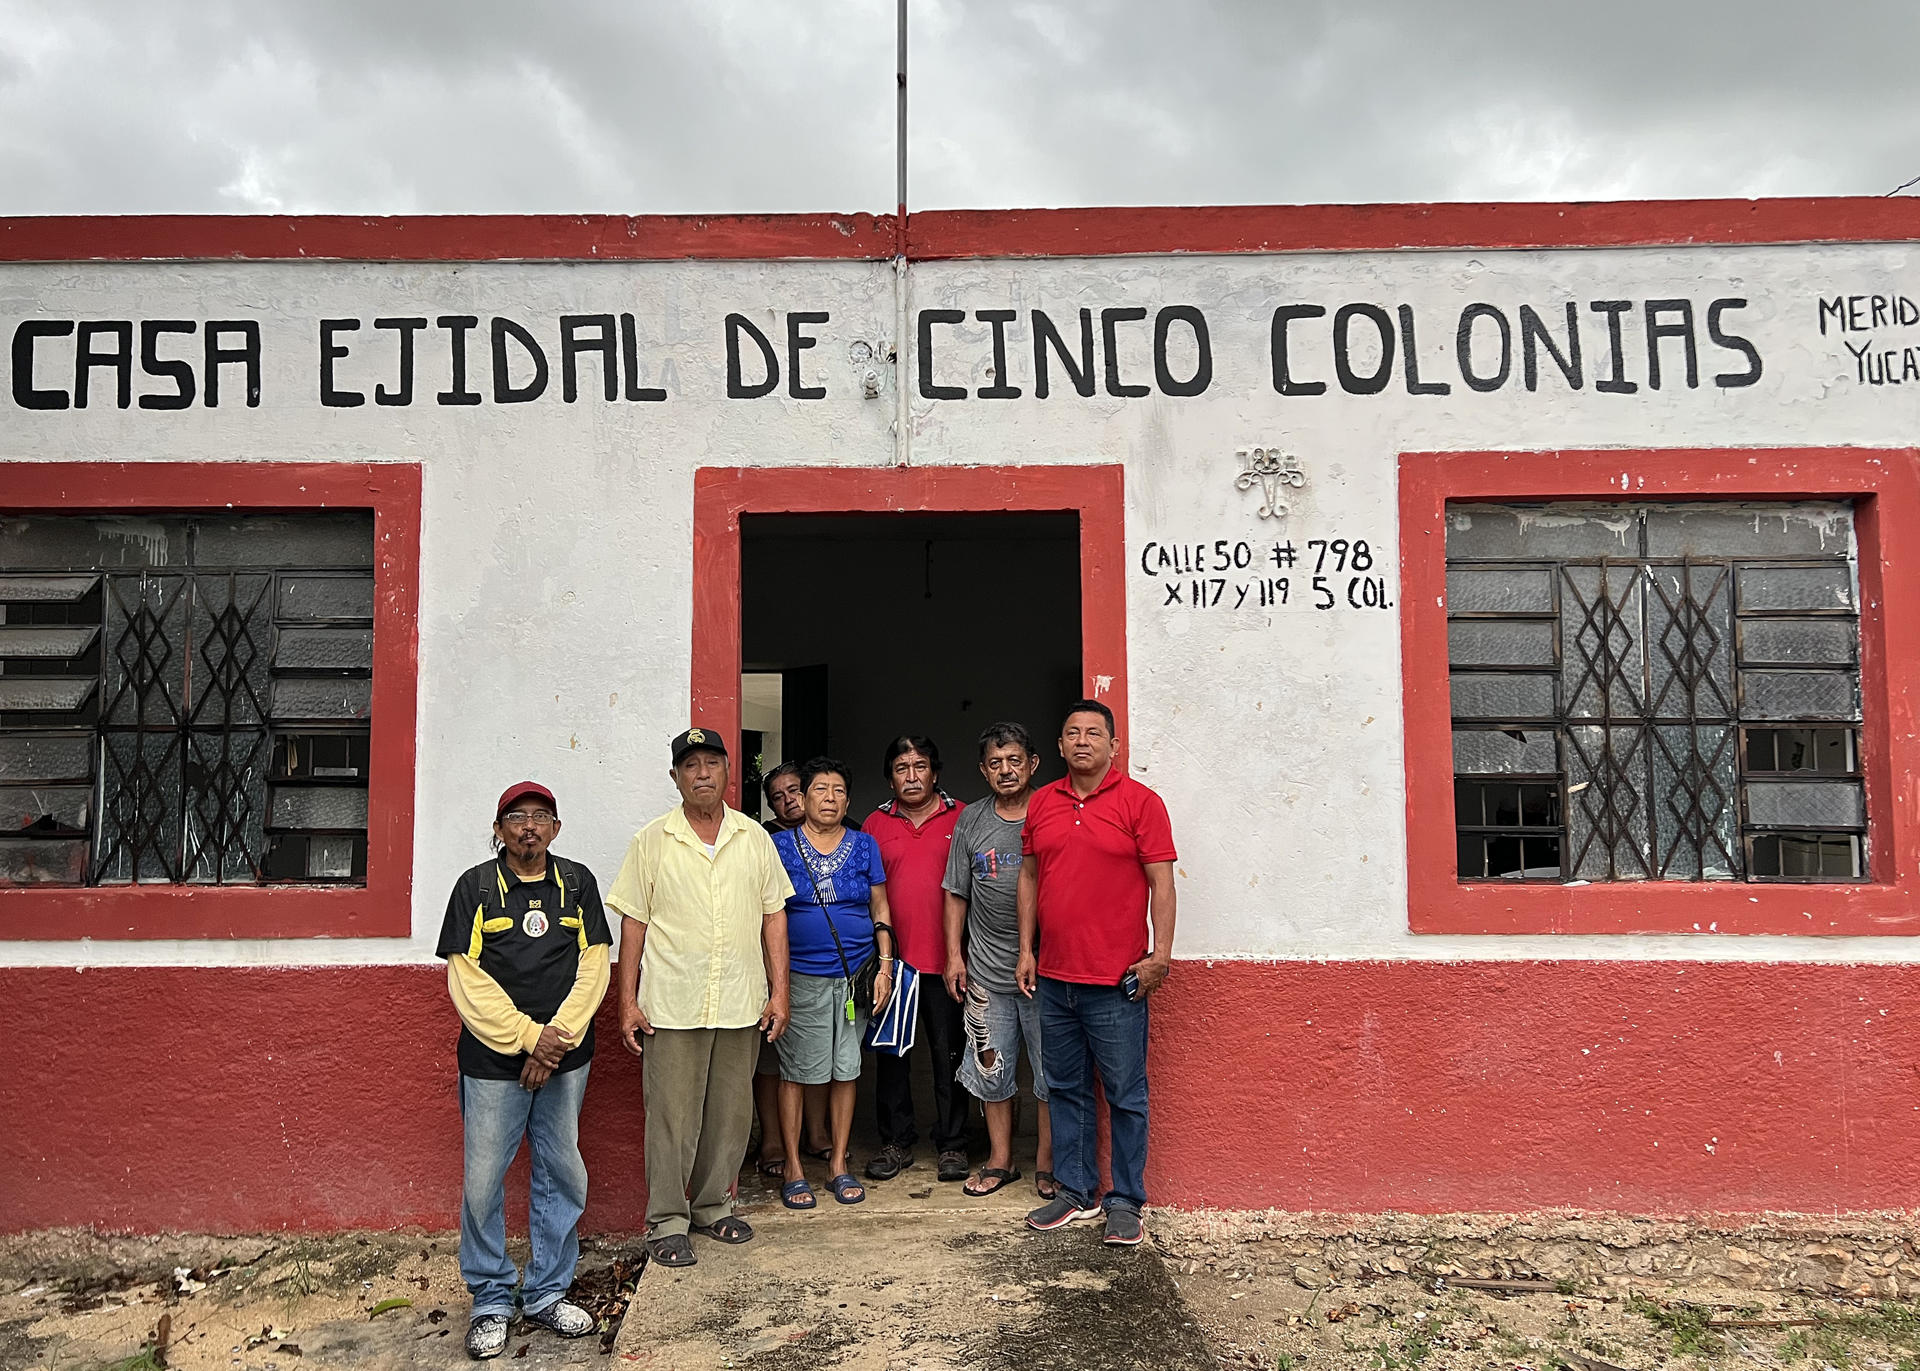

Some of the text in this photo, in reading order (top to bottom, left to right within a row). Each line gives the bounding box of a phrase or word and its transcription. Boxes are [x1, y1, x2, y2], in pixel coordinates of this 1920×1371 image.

[1819, 294, 1919, 336] MERID
[11, 298, 1763, 411] CASA EJIDAL DE CINCO COLONIAS
[1843, 340, 1920, 385] YUCA
[1141, 539, 1374, 577] CALLE 50 # 798
[1192, 578, 1226, 609] 117
[1259, 577, 1290, 608] 119
[1312, 576, 1336, 611] 5
[1347, 576, 1395, 611] COL.
